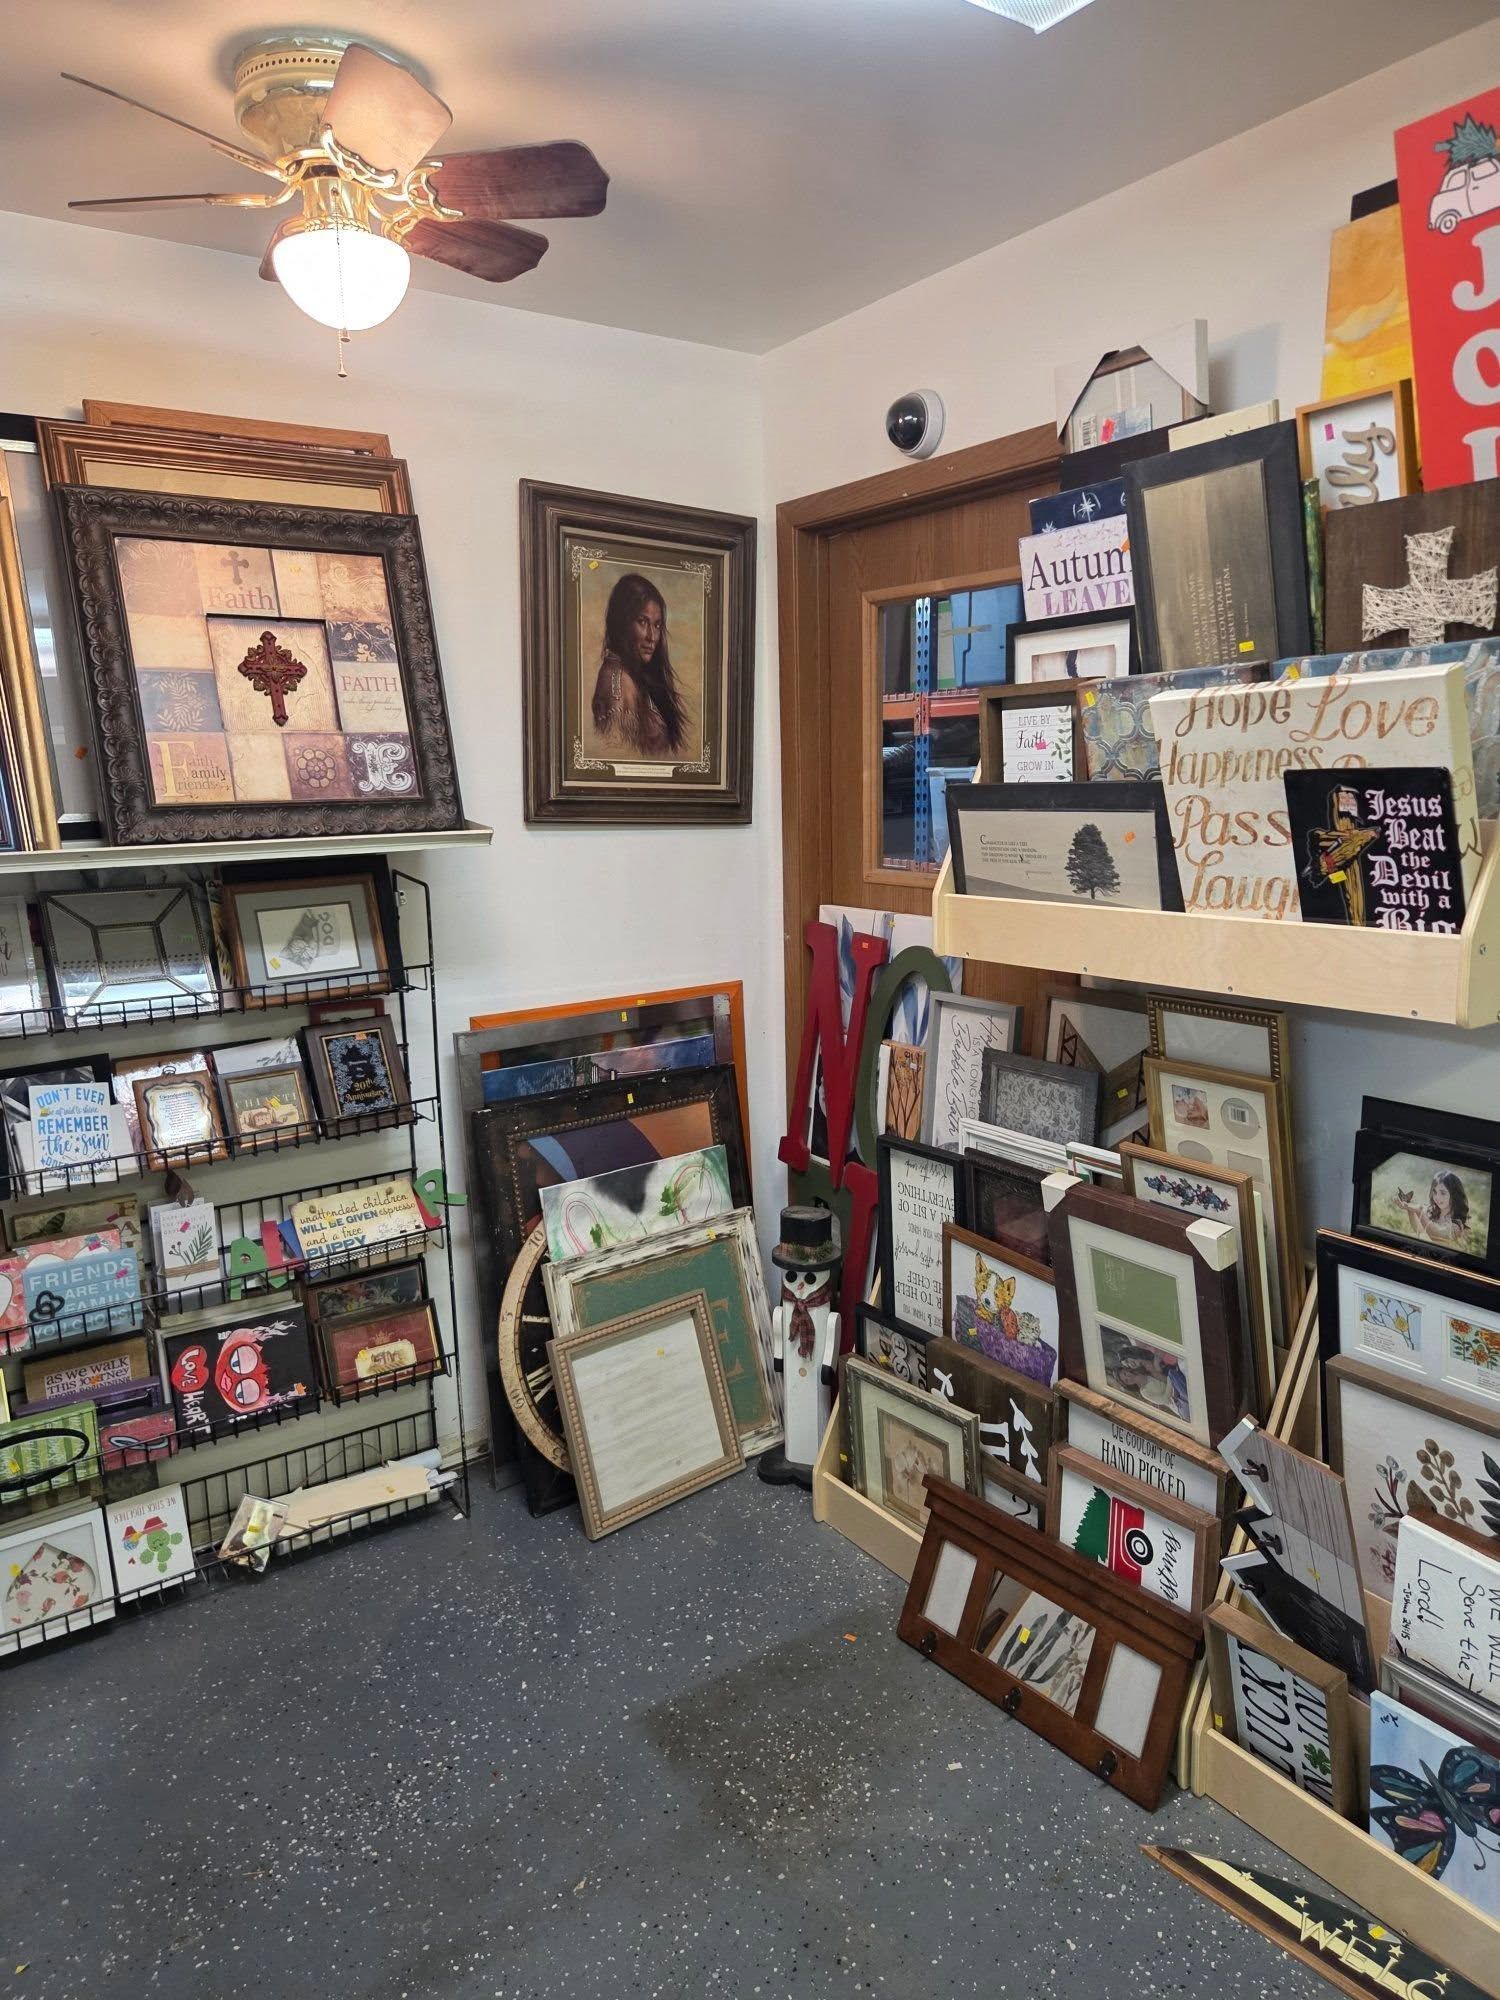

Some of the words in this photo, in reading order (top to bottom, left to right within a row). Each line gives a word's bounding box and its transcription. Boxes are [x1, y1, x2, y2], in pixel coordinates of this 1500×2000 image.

[207, 586, 275, 611] Faith
[341, 676, 398, 692] FAITH
[1018, 715, 1037, 726] LIVE
[1040, 714, 1051, 725] BY
[1175, 680, 1292, 738] Hope
[1289, 675, 1440, 742] Love
[1017, 761, 1043, 771] GROW
[1044, 760, 1055, 771] IN
[1365, 789, 1443, 820] Jesus
[1384, 819, 1447, 853] Beat
[1367, 854, 1453, 890] Devil
[1402, 852, 1431, 871] the
[1381, 888, 1430, 913] with
[1438, 895, 1452, 909] a
[318, 911, 335, 946] DOG
[950, 1014, 972, 1090] Bubble
[968, 1063, 979, 1099] LONG
[36, 1088, 70, 1108] DON'T
[76, 1088, 105, 1106] EVER
[946, 1083, 968, 1137] Bath
[37, 1115, 109, 1135] REMEMBER
[39, 1134, 72, 1156] the
[363, 1189, 409, 1210] children
[897, 1199, 910, 1212] OF
[912, 1203, 928, 1219] BIT
[930, 1205, 937, 1217] A
[300, 1223, 328, 1236] WILL
[346, 1210, 379, 1226] GIVEN
[378, 1201, 416, 1218] espresso
[306, 1232, 329, 1248] and
[333, 1233, 339, 1241] a
[341, 1225, 364, 1239] free
[306, 1235, 368, 1259] PUPPY
[29, 1257, 134, 1292] FRIENDS
[907, 1270, 931, 1289] CHEF
[65, 1283, 100, 1300] ARE
[104, 1275, 136, 1292] THE
[895, 1280, 919, 1299] HELP
[921, 1292, 933, 1307] TO
[46, 1374, 63, 1387] as
[1112, 1423, 1124, 1443] WE
[1101, 1438, 1135, 1477] HAND
[1138, 1458, 1186, 1502] PICKED
[1458, 1576, 1486, 1629] Serve
